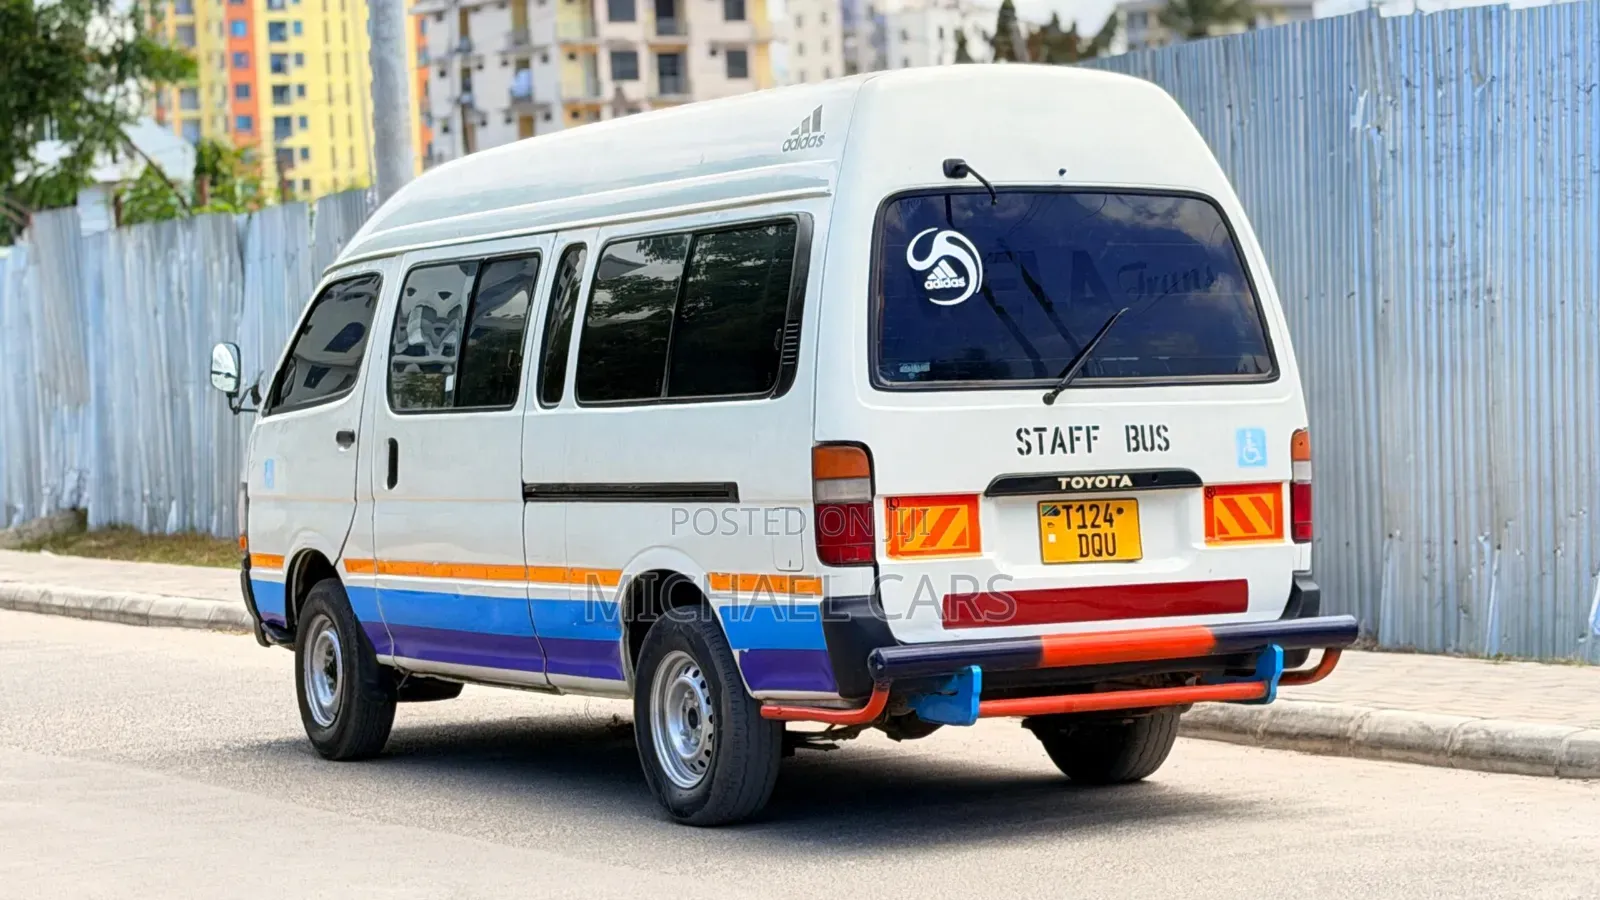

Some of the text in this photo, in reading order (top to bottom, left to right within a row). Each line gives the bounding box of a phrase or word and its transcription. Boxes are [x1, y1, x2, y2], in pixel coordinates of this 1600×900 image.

[782, 132, 825, 153] adidas
[924, 275, 966, 290] adidas
[1016, 424, 1170, 456] STAFF BUS
[1058, 475, 1133, 490] TOYOTA
[1062, 504, 1115, 529] T124
[1078, 532, 1117, 557] DQU
